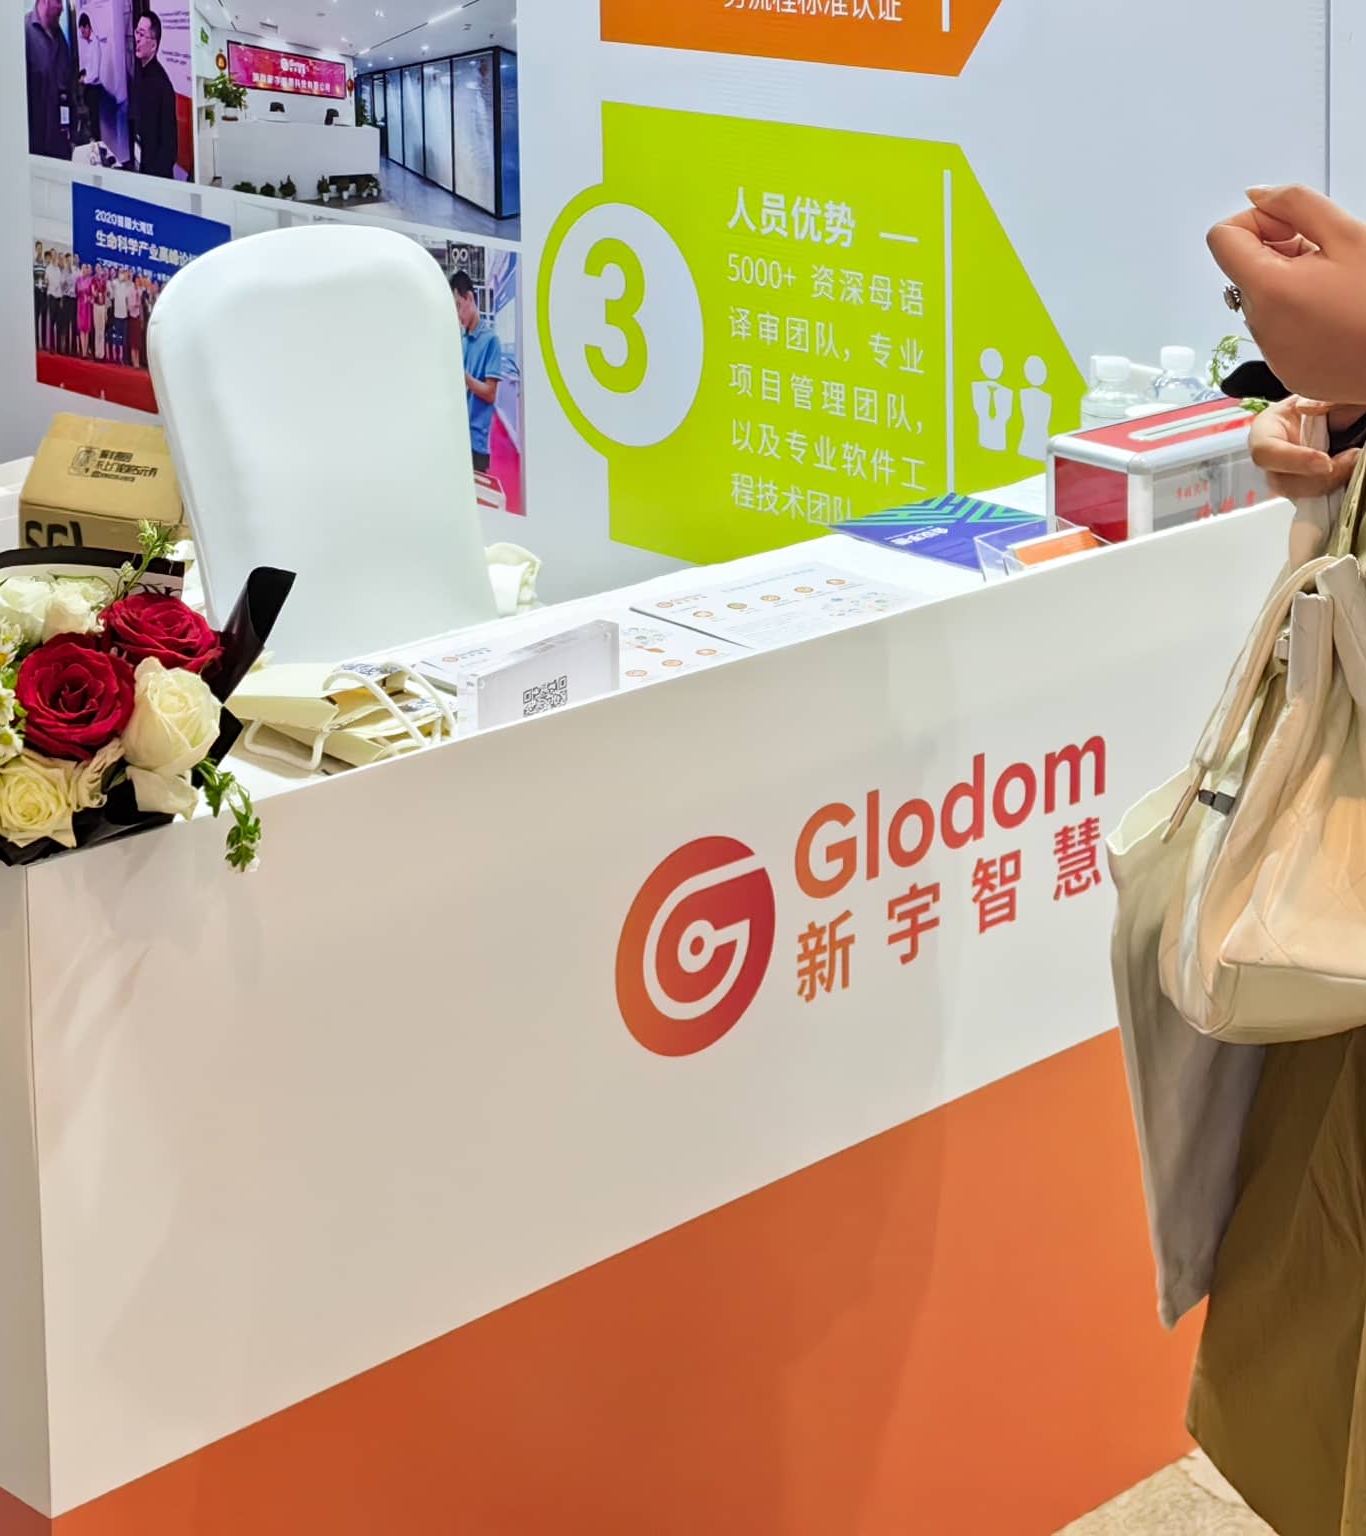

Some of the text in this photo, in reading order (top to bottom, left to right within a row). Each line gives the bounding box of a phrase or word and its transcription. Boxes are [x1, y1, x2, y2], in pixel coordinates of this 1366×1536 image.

[727, 187, 857, 248] 人员优势
[584, 237, 649, 394] 3
[727, 252, 925, 318] 5000+ 资深母语
[728, 306, 925, 376] 译审团队，专业
[728, 362, 925, 435] 项目管理团队，
[730, 418, 927, 493] 以及专业软件工
[795, 735, 1106, 900] Glodom
[796, 816, 1103, 1004] 新宇智慧
